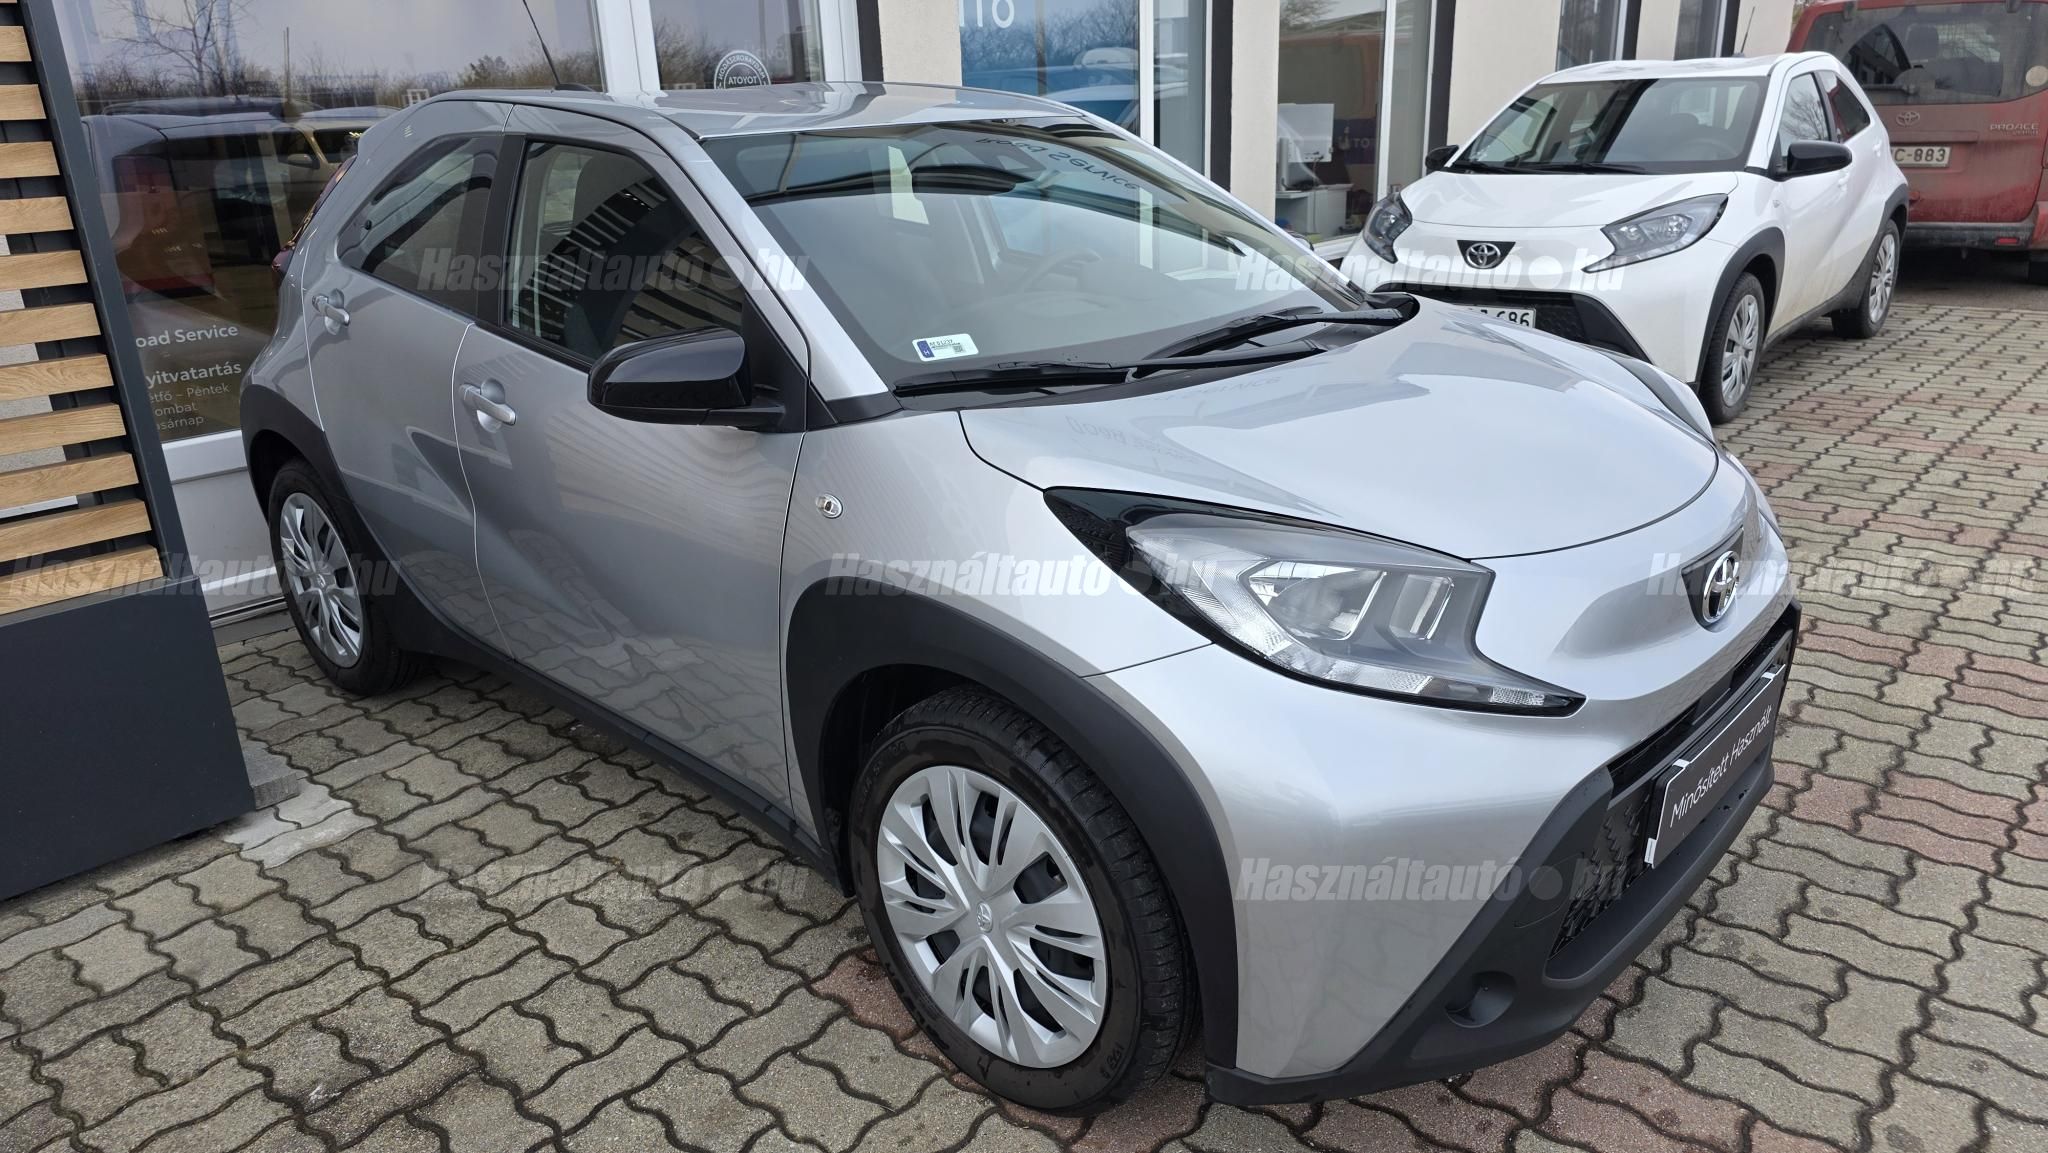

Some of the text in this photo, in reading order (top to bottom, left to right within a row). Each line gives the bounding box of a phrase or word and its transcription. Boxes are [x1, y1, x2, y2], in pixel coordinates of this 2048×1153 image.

[1990, 122, 2040, 132] PROACE
[1891, 147, 1947, 163] C-883
[135, 324, 239, 348] oad Service
[145, 361, 242, 389] yitvatartás
[154, 402, 199, 417] ombat
[157, 416, 205, 432] sárnap
[1669, 703, 1773, 829] Minősített Használt
